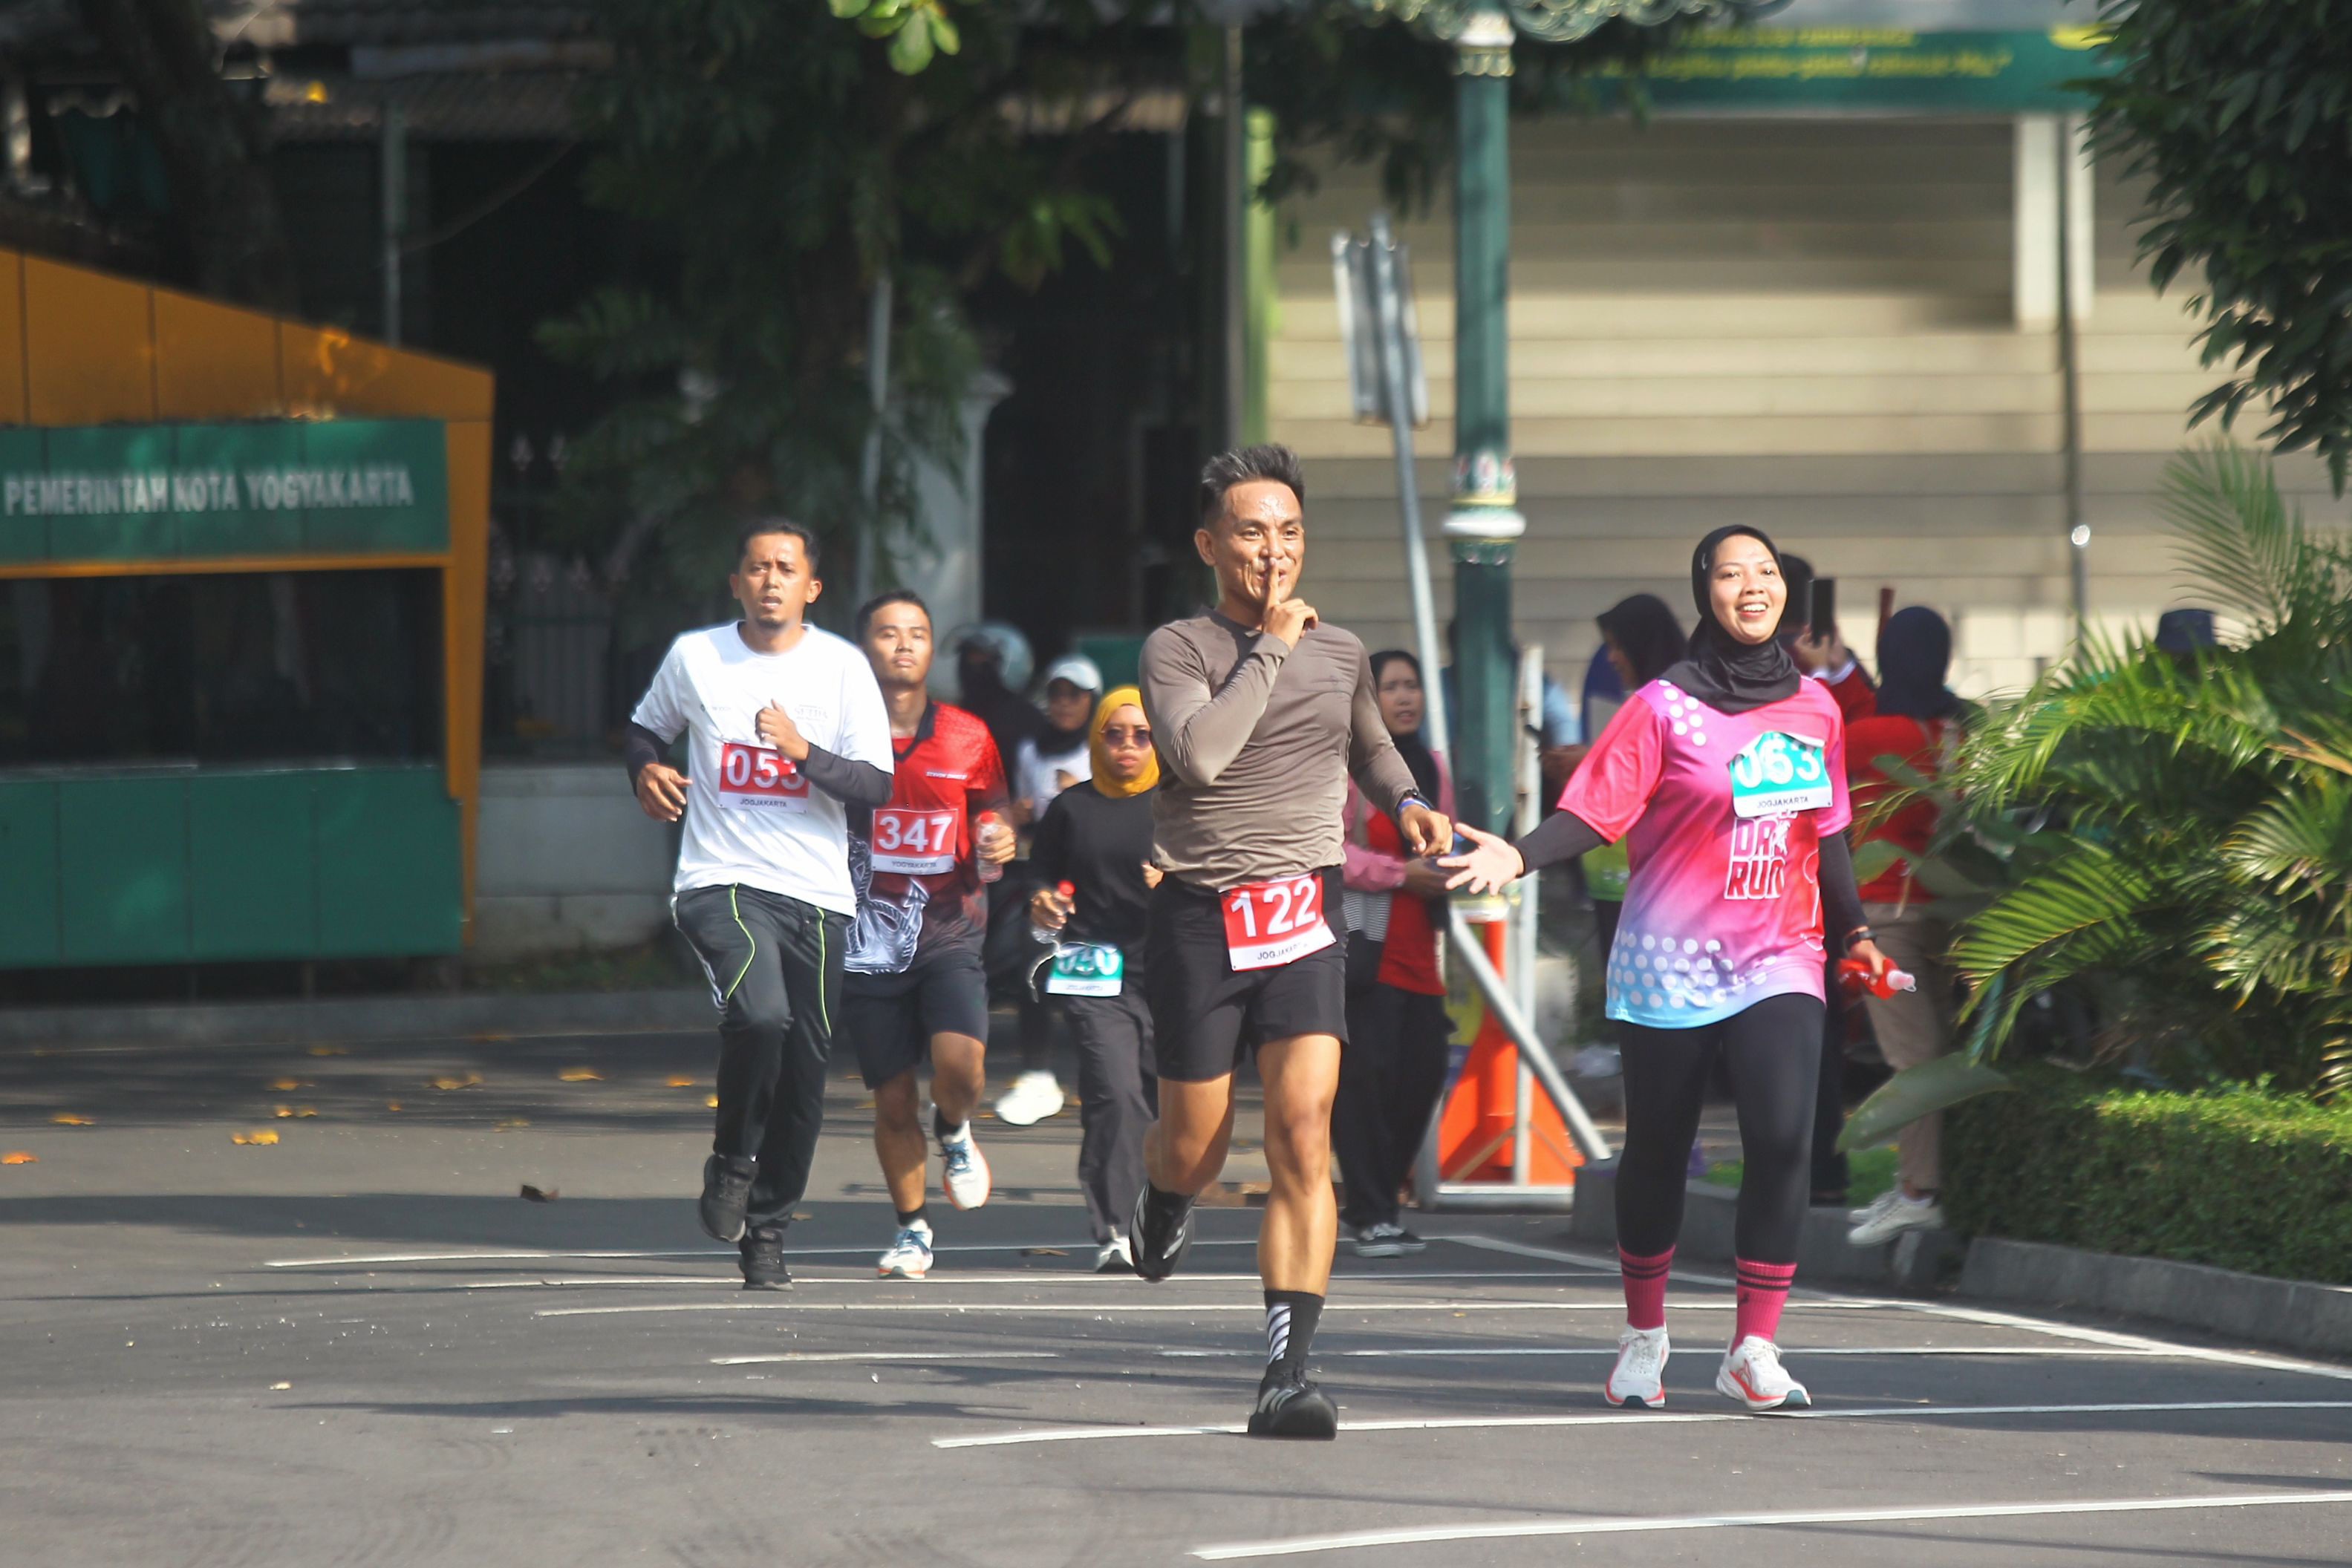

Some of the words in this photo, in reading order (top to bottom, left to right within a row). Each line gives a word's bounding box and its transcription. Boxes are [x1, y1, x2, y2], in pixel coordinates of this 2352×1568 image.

[6, 475, 168, 514] PEMERINTAH
[174, 474, 238, 511] KOTA
[246, 470, 413, 509] YOGYAKARTA
[1735, 737, 1821, 788] 063
[740, 798, 787, 808] JOGJAKARTA
[1757, 797, 1808, 808] JOGJAKARTA
[878, 816, 952, 852] 347
[1231, 880, 1316, 937] 122
